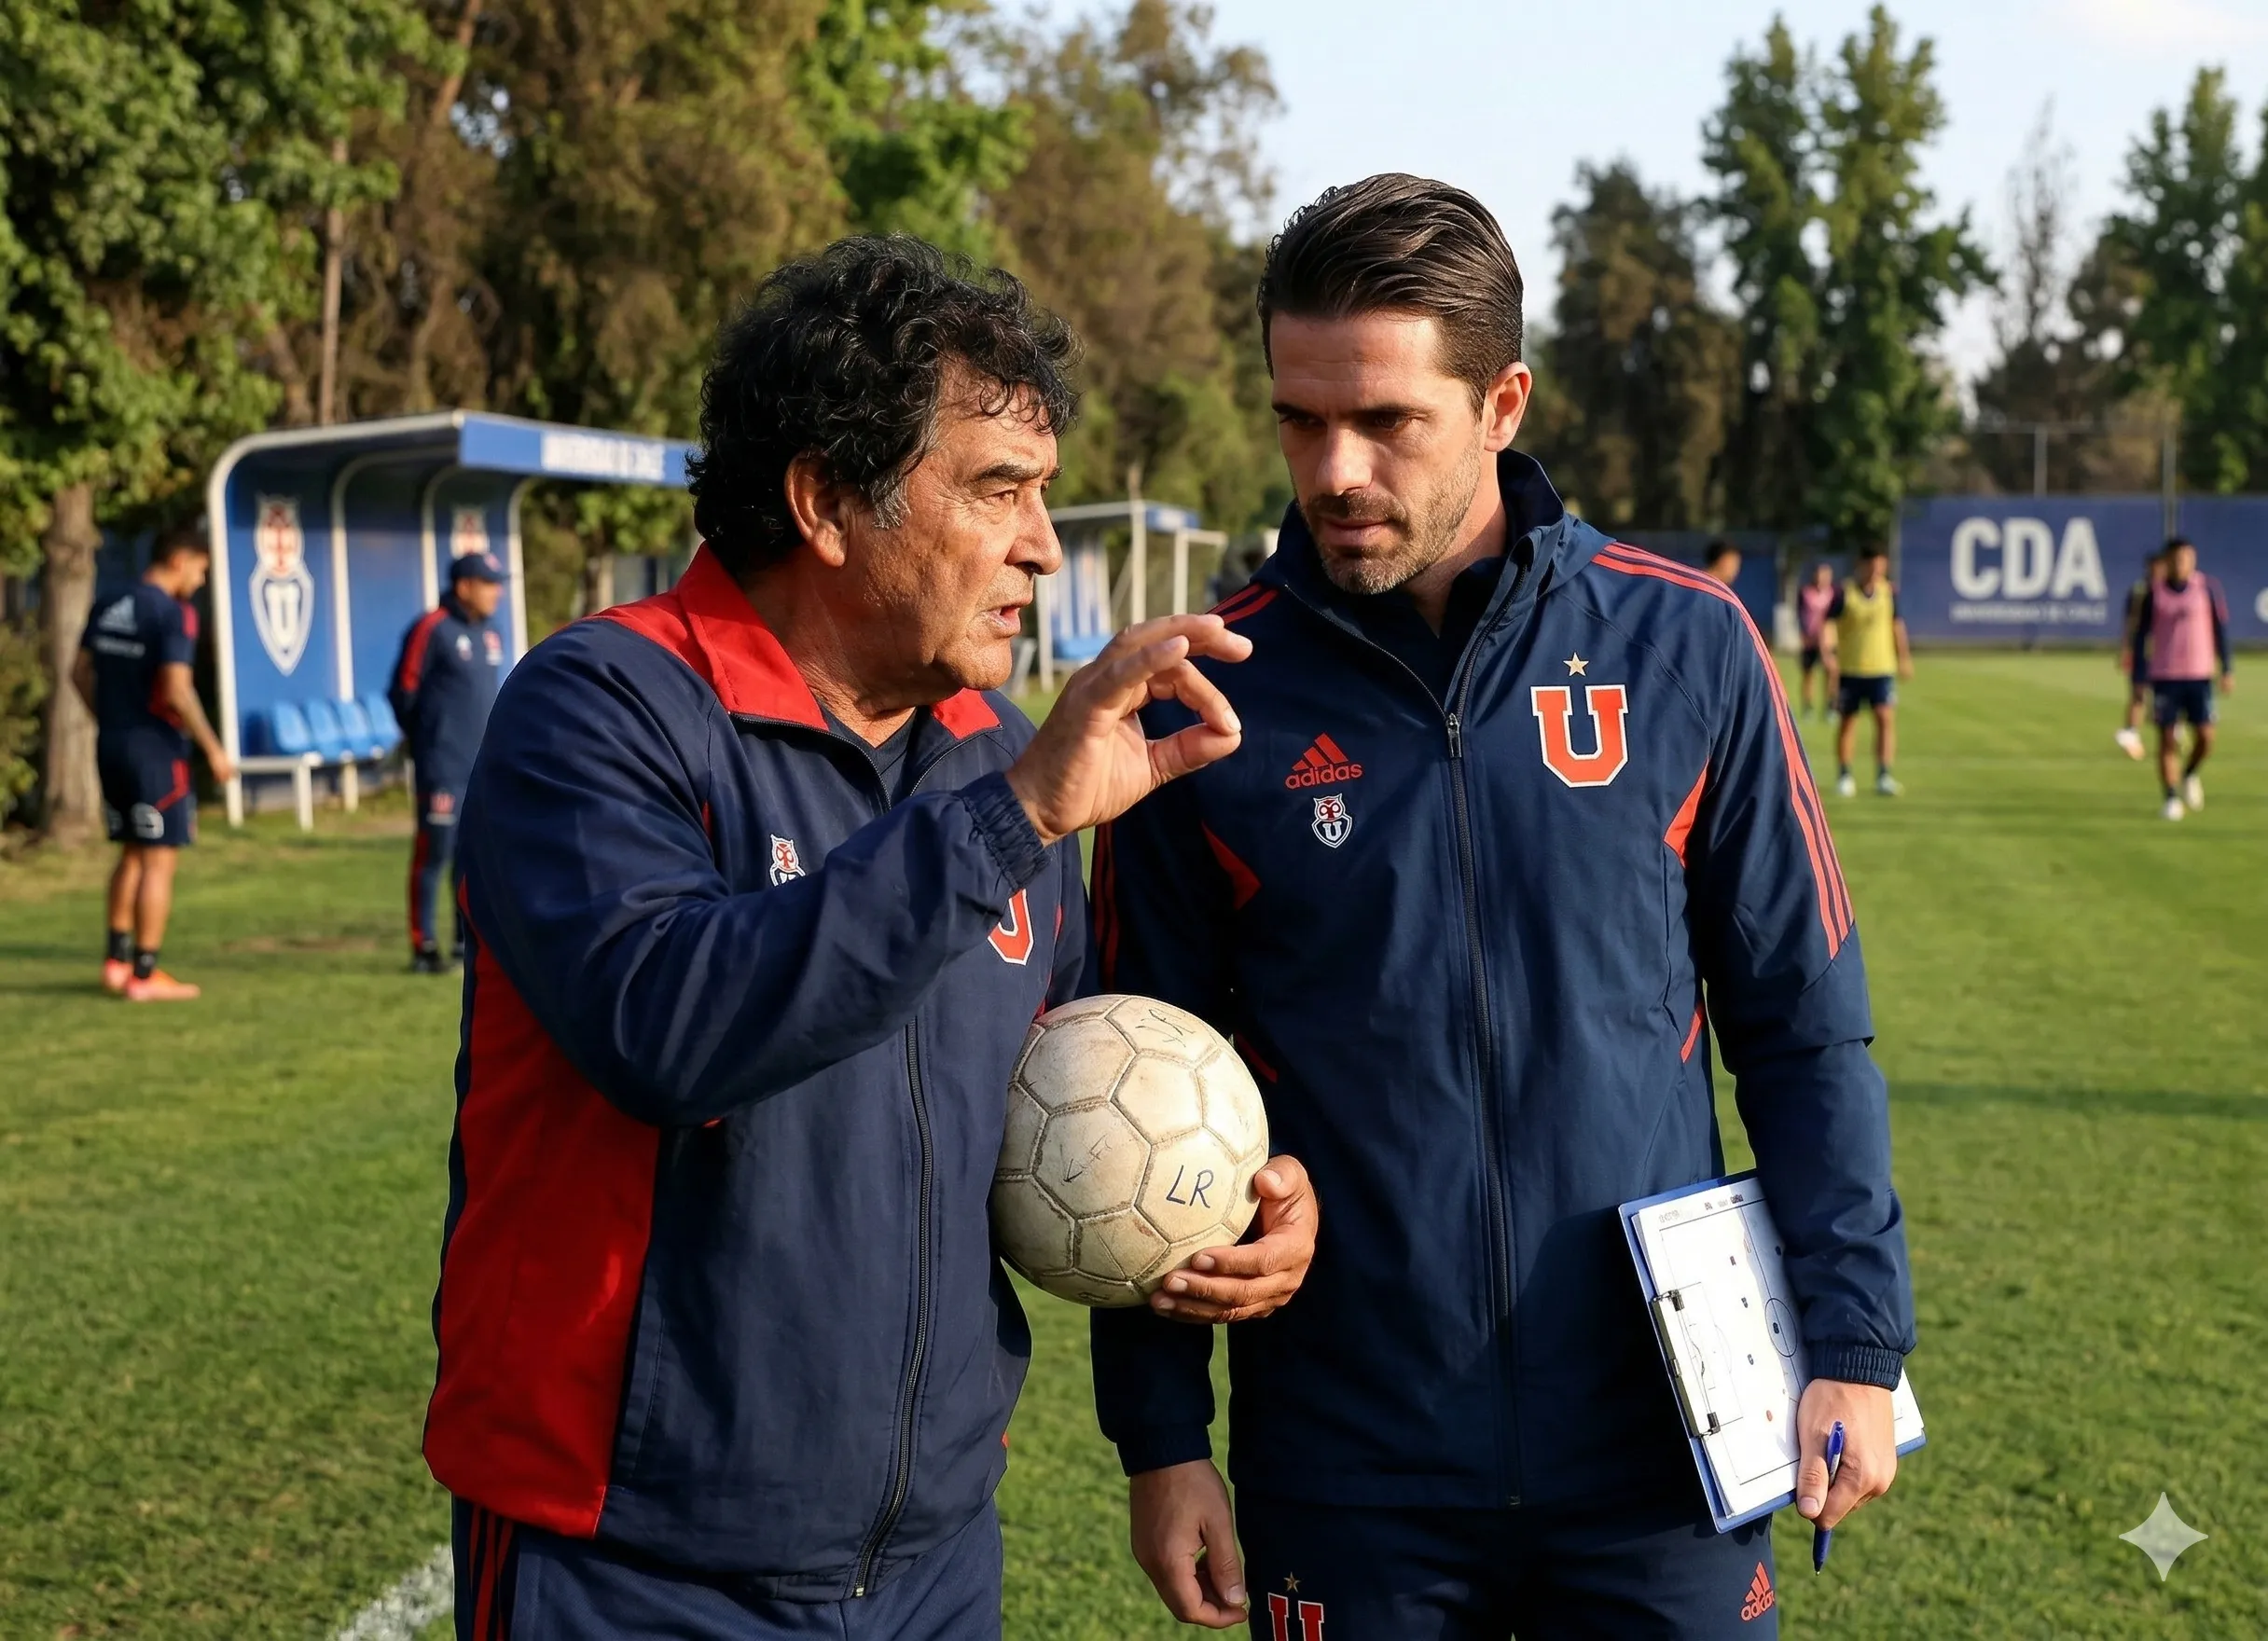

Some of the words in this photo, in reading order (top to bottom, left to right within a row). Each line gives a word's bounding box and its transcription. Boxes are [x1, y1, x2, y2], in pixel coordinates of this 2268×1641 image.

[1950, 516, 2109, 600] CDA
[1530, 683, 1629, 788] U
[1285, 764, 1363, 790] adidas
[1322, 820, 1343, 842] U
[1166, 1165, 1214, 1209] LR
